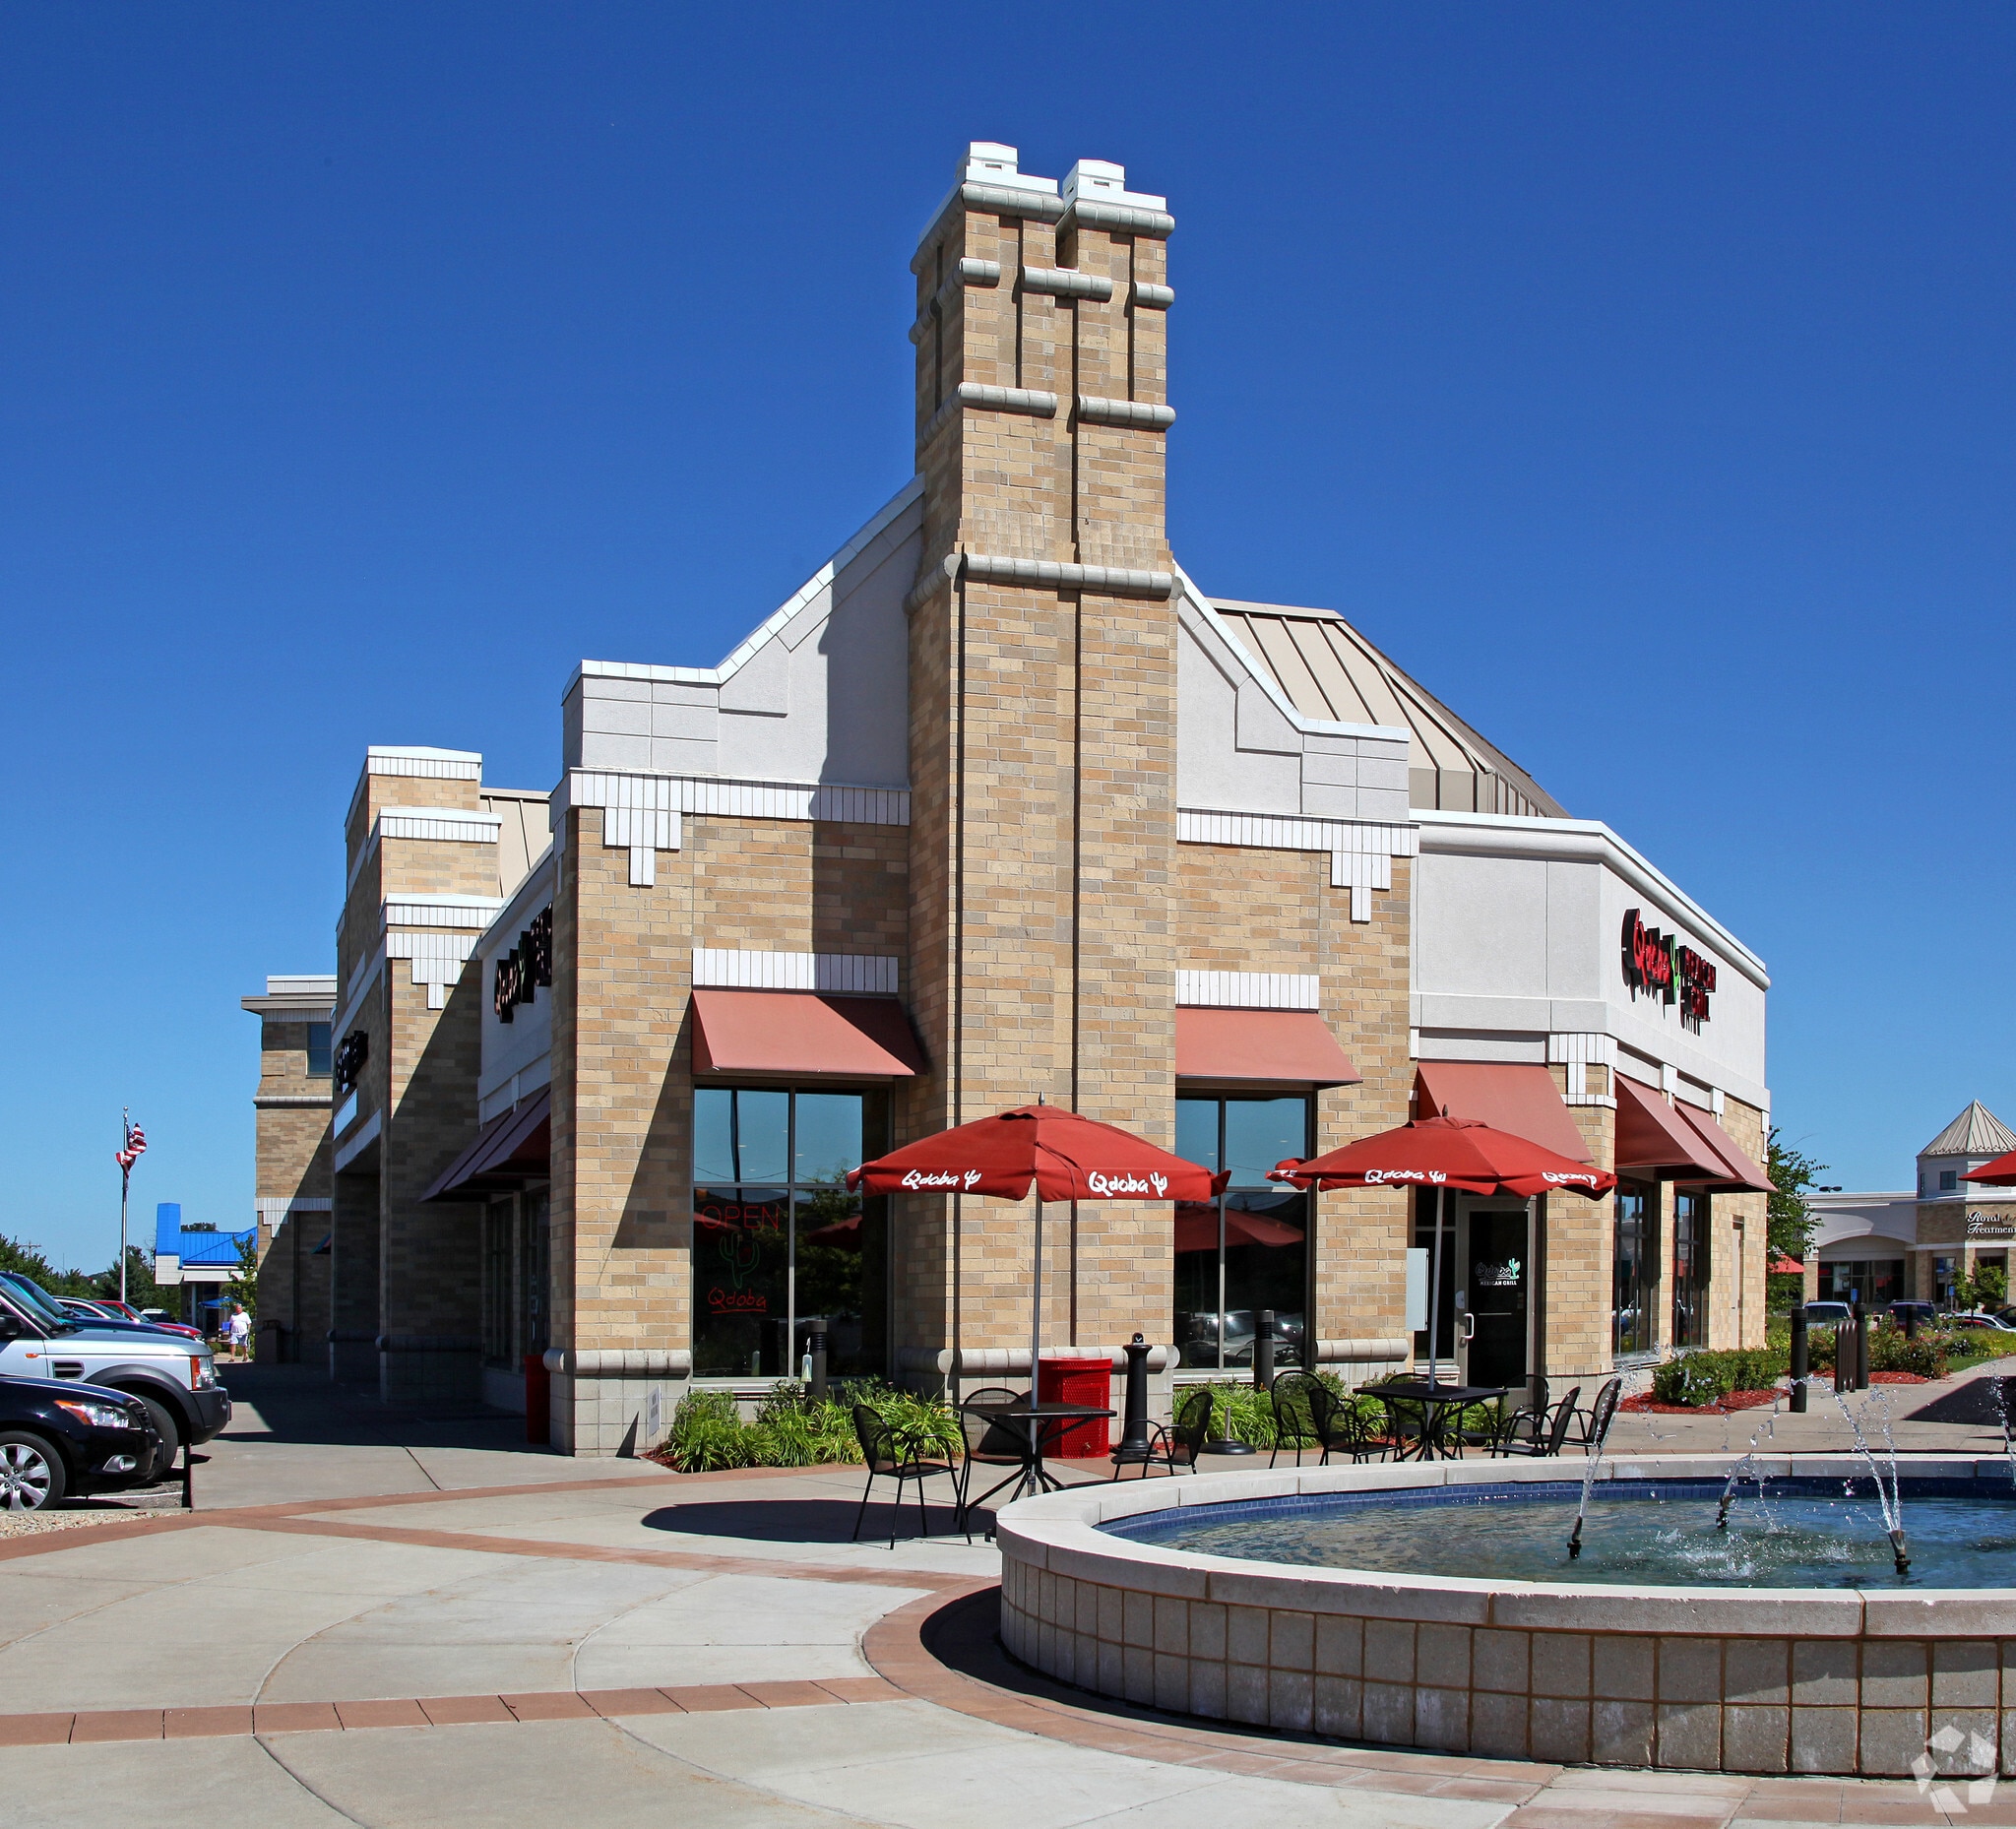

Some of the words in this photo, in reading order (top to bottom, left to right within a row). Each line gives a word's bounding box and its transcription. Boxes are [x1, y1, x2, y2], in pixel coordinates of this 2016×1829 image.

[1622, 908, 1670, 989] Qdoba
[901, 1168, 960, 1190] Qdoba
[1088, 1170, 1150, 1198] Qdoba
[1365, 1168, 1425, 1183] Qdoba
[701, 1205, 780, 1230] OPEN
[707, 1286, 767, 1310] Qdoba
